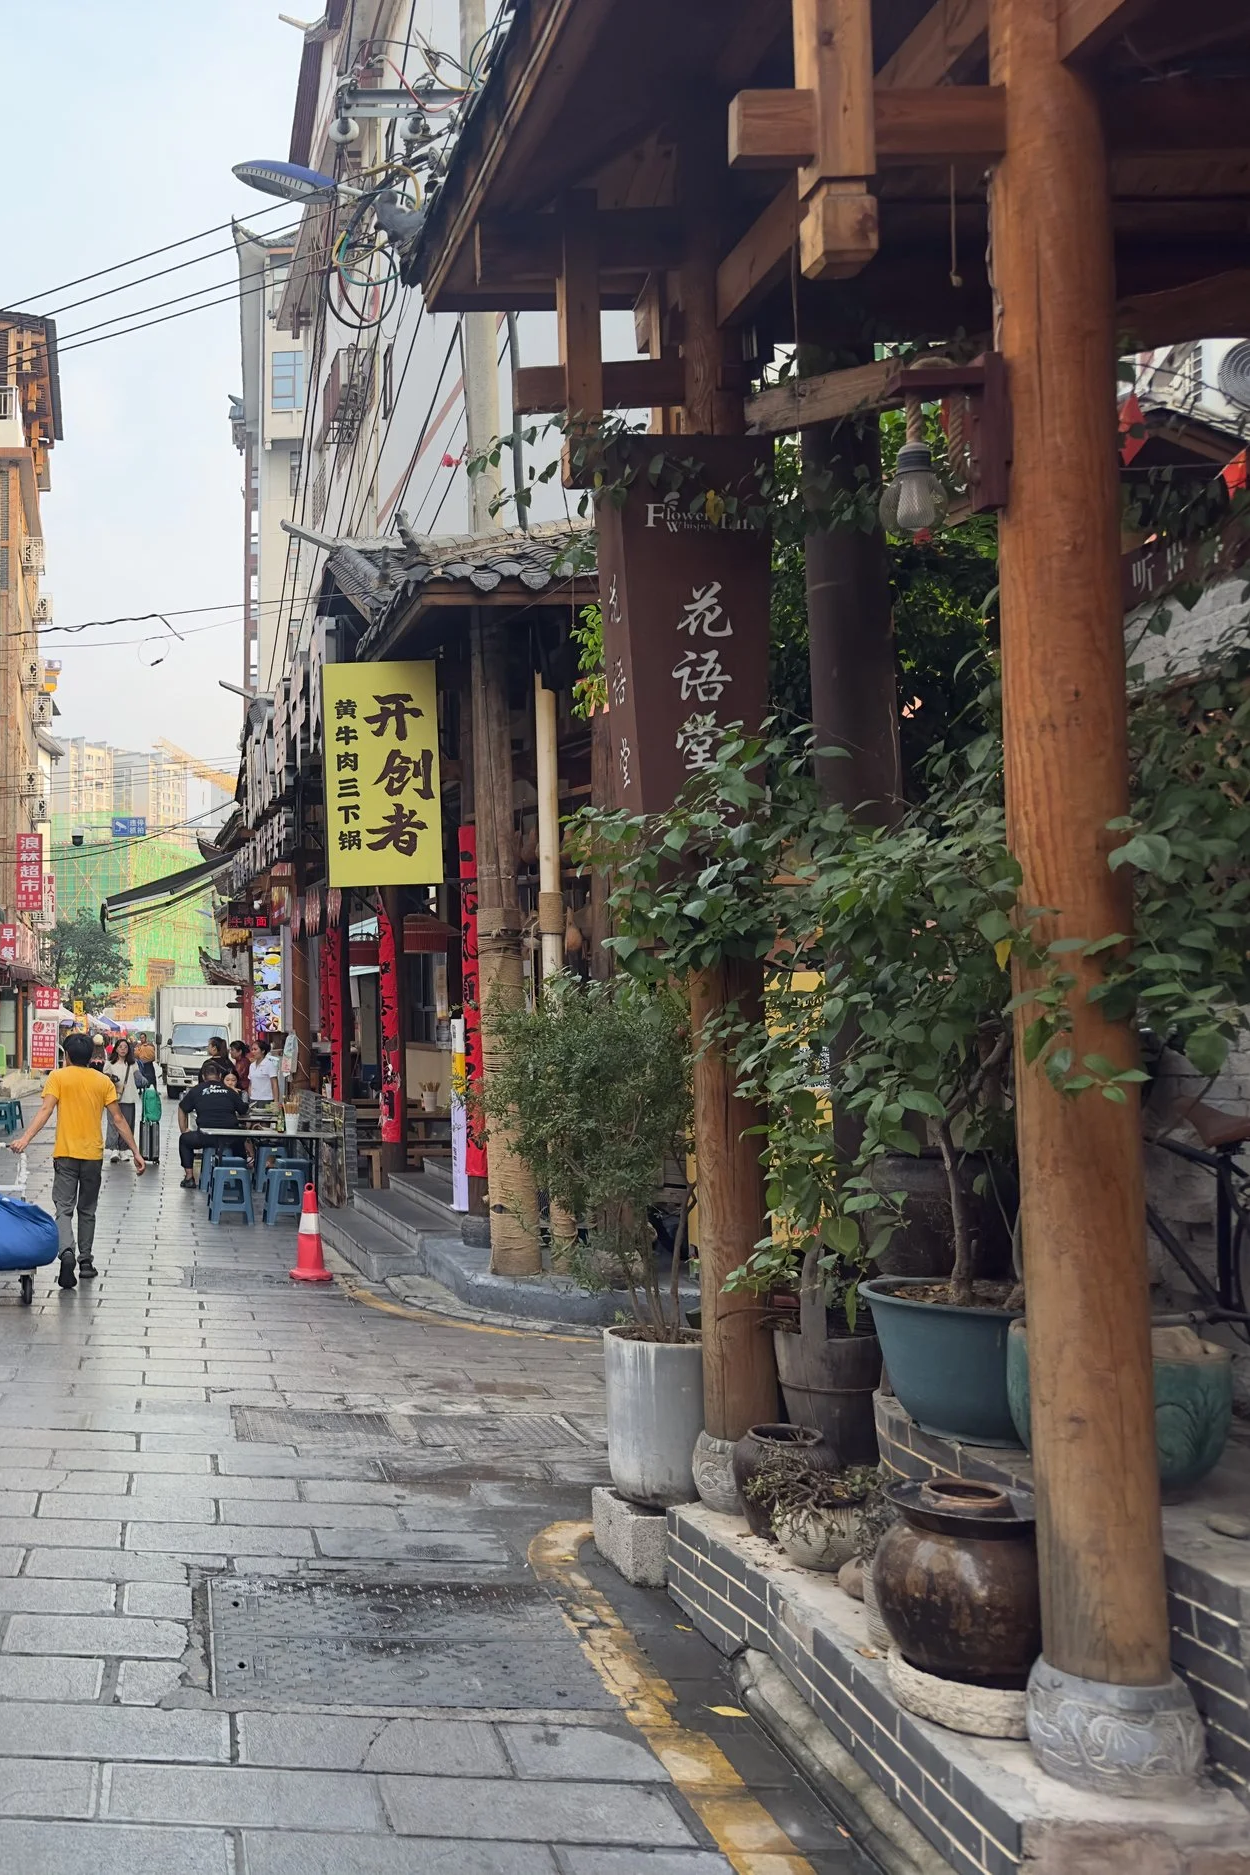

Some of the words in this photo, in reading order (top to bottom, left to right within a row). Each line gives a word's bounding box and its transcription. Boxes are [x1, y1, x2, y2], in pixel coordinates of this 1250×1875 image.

[334, 699, 362, 852] 黄牛肉三下锅
[363, 692, 435, 856] 开创者
